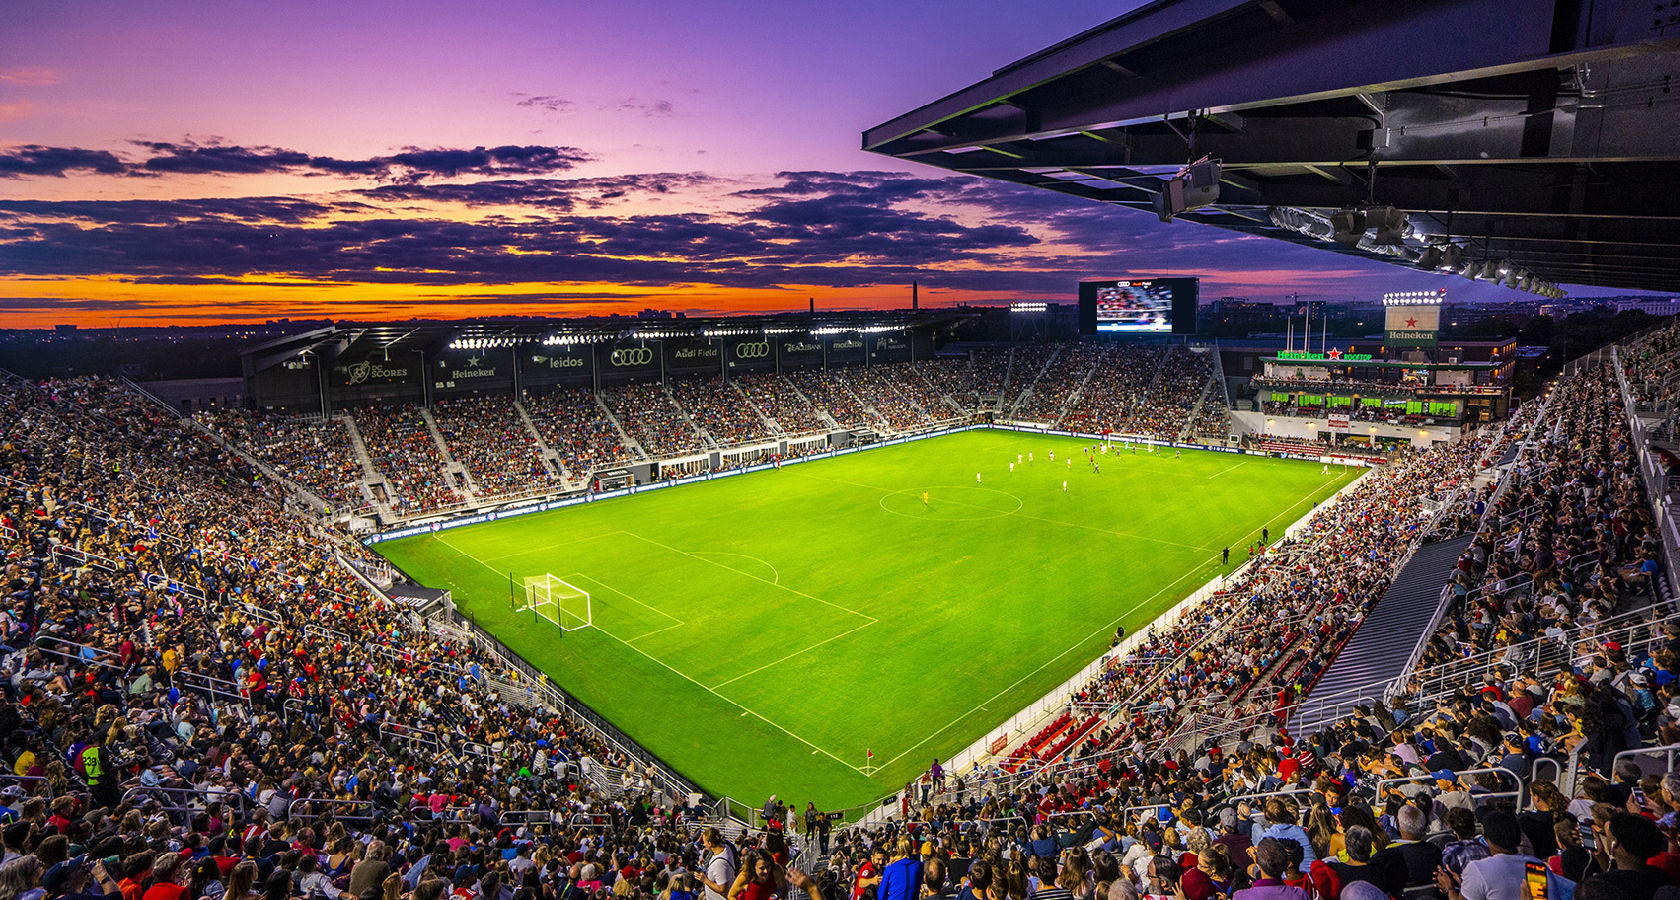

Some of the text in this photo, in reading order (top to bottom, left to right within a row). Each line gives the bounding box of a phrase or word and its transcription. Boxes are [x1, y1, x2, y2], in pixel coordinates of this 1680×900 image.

[1389, 331, 1434, 340] Heineken
[675, 348, 718, 358] Audi Field
[1277, 350, 1324, 360] Heineken
[550, 356, 584, 368] leidos
[372, 368, 408, 378] SCORES
[452, 368, 495, 378] Heineken
